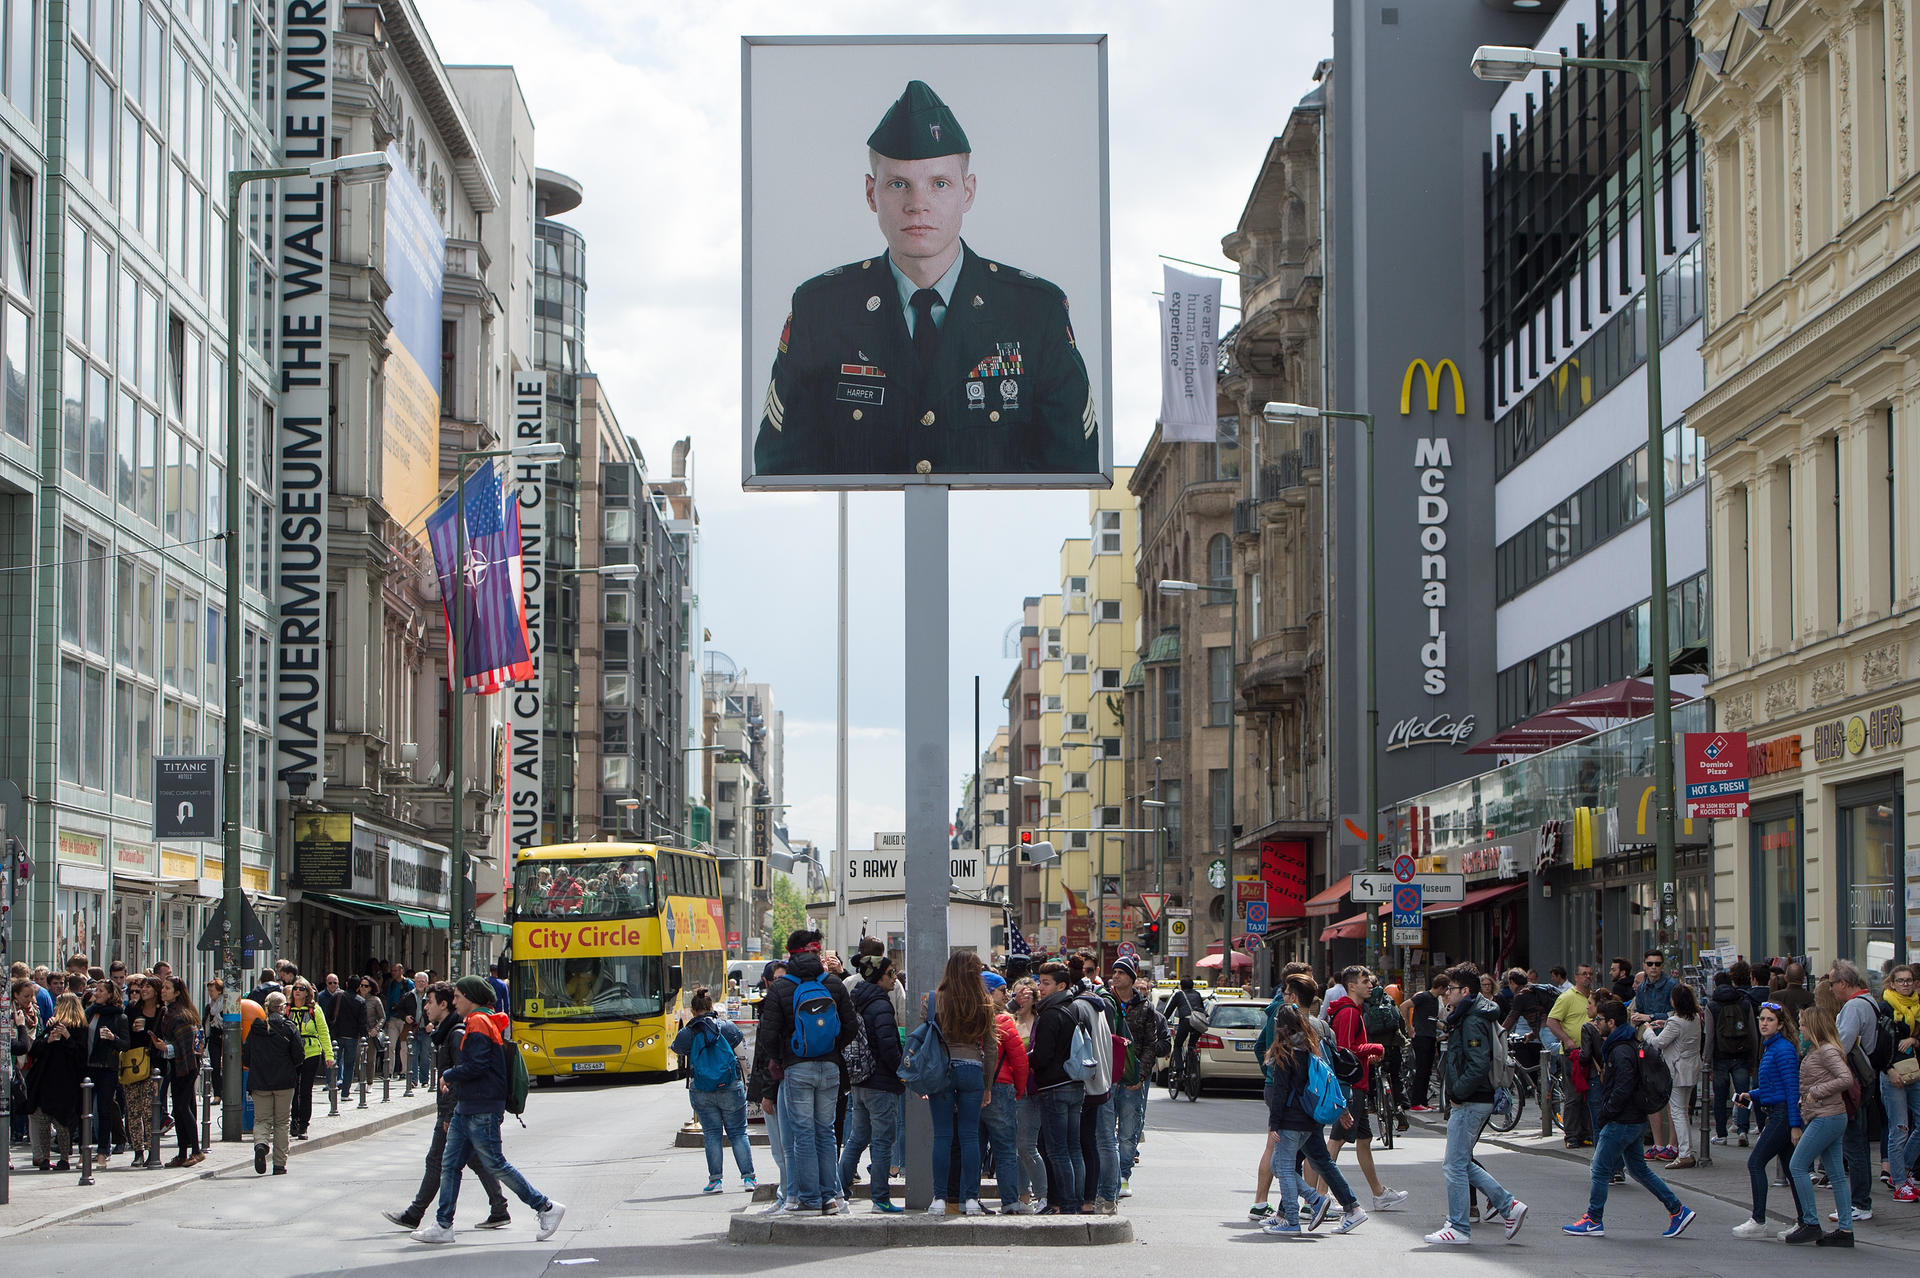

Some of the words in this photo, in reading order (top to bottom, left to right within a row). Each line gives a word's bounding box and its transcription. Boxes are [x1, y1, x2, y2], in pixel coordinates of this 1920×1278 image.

[286, 0, 327, 100] MUR
[285, 115, 325, 158] LE
[284, 182, 323, 301] WALL
[1203, 294, 1213, 313] we
[1186, 293, 1200, 341] human
[1201, 316, 1212, 338] are
[281, 315, 322, 392] THE
[1200, 340, 1213, 366] less
[1185, 344, 1198, 399] without
[846, 387, 874, 399] HARPER
[517, 382, 542, 508] CHRLIE
[278, 418, 322, 781] MAUERMUSEUM
[1869, 703, 1903, 750] GIFTS
[1814, 720, 1845, 764] GIRLS
[513, 729, 539, 780] AM
[1699, 760, 1734, 768] Domino's
[163, 762, 208, 772] TITANIC
[1691, 785, 1708, 796] HOT
[1709, 784, 1718, 794] &
[1719, 781, 1745, 793] FRESH
[1699, 808, 1728, 816] KOCHSTR.
[756, 811, 765, 855] HOTE
[882, 834, 900, 846] ALLIED
[849, 860, 857, 878] S
[863, 859, 898, 878] ARMY
[1262, 845, 1305, 869] Pizza
[1260, 861, 1306, 886] Pasta
[1266, 879, 1305, 903] Salat
[1247, 922, 1266, 932] TAXI
[1395, 914, 1420, 925] TAXI
[528, 927, 572, 953] City
[578, 924, 641, 948] Circle
[1402, 932, 1419, 940] Taxen
[531, 1002, 539, 1014] 9
